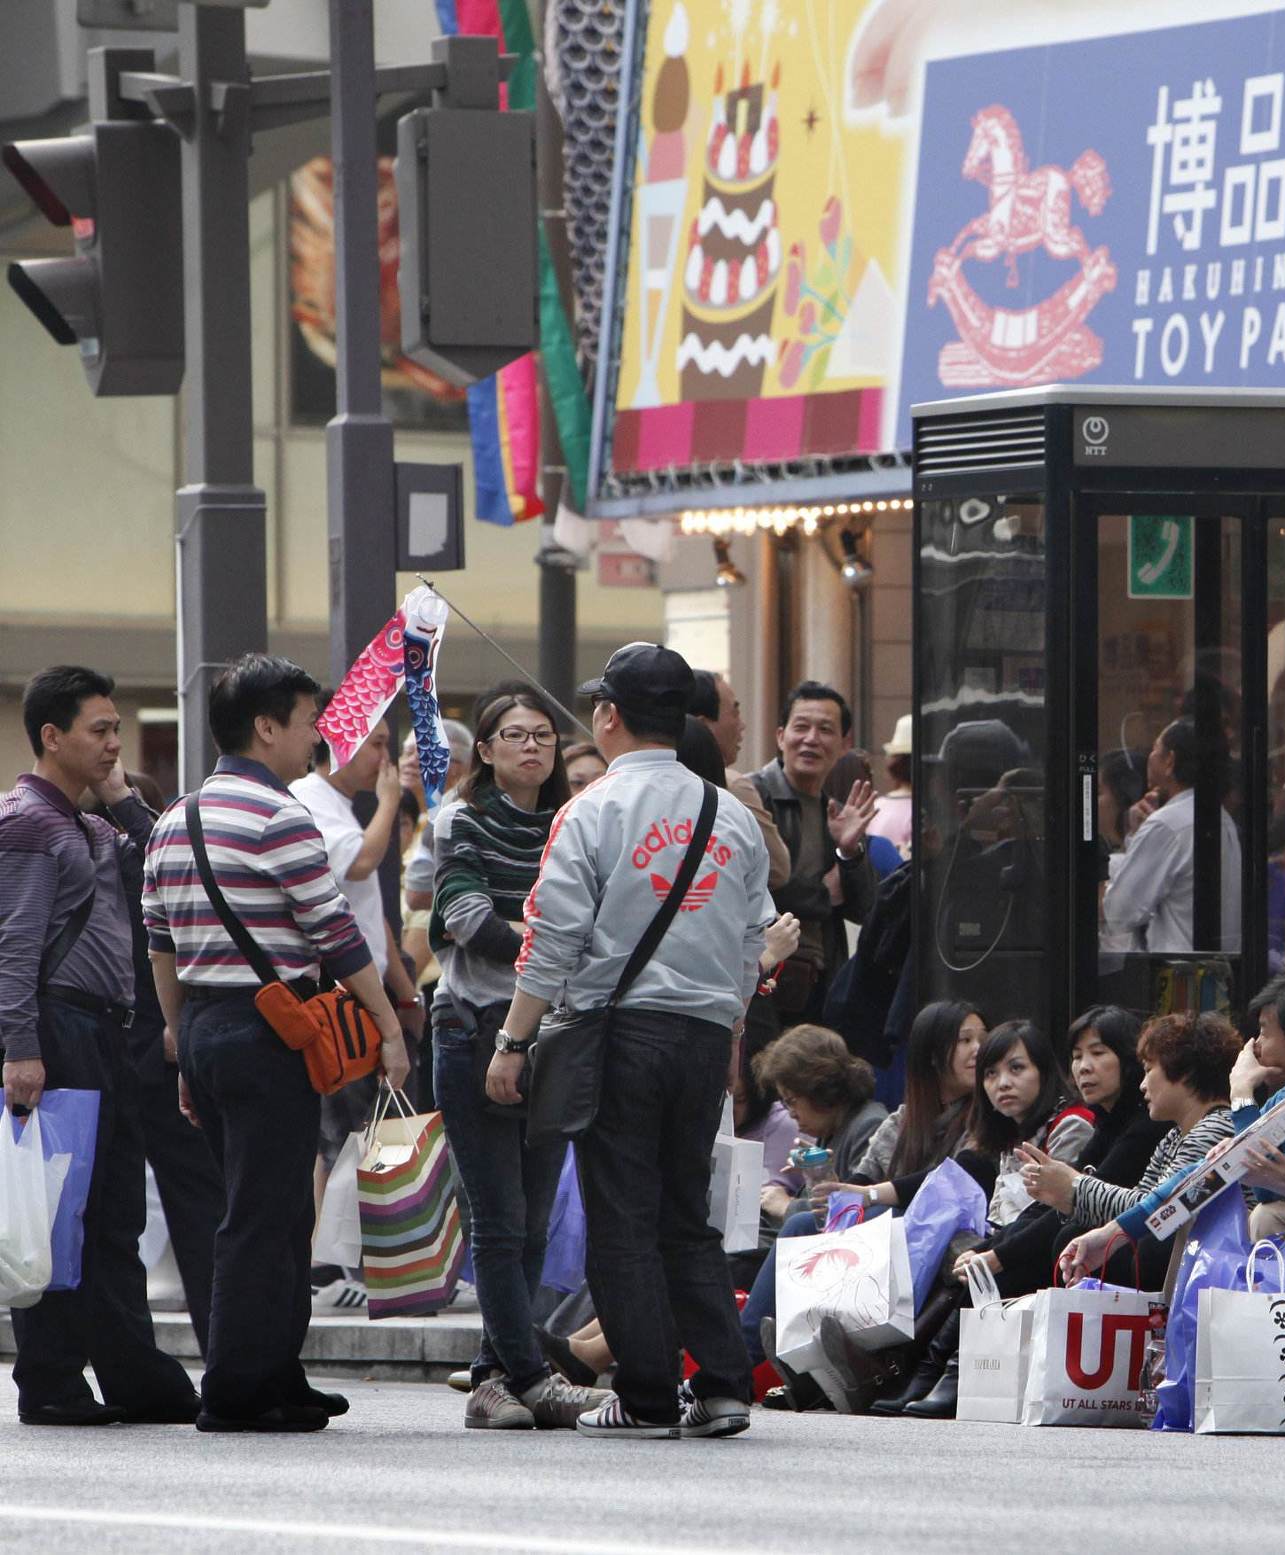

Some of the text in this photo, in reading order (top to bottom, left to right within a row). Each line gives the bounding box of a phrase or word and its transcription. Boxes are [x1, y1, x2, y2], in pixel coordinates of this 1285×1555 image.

[1132, 309, 1226, 379] TOY
[1084, 446, 1108, 456] NTT
[1064, 1311, 1152, 1392] UT
[1062, 1398, 1077, 1409] UT
[1079, 1398, 1098, 1410] ALL
[1100, 1400, 1132, 1412] STARS
